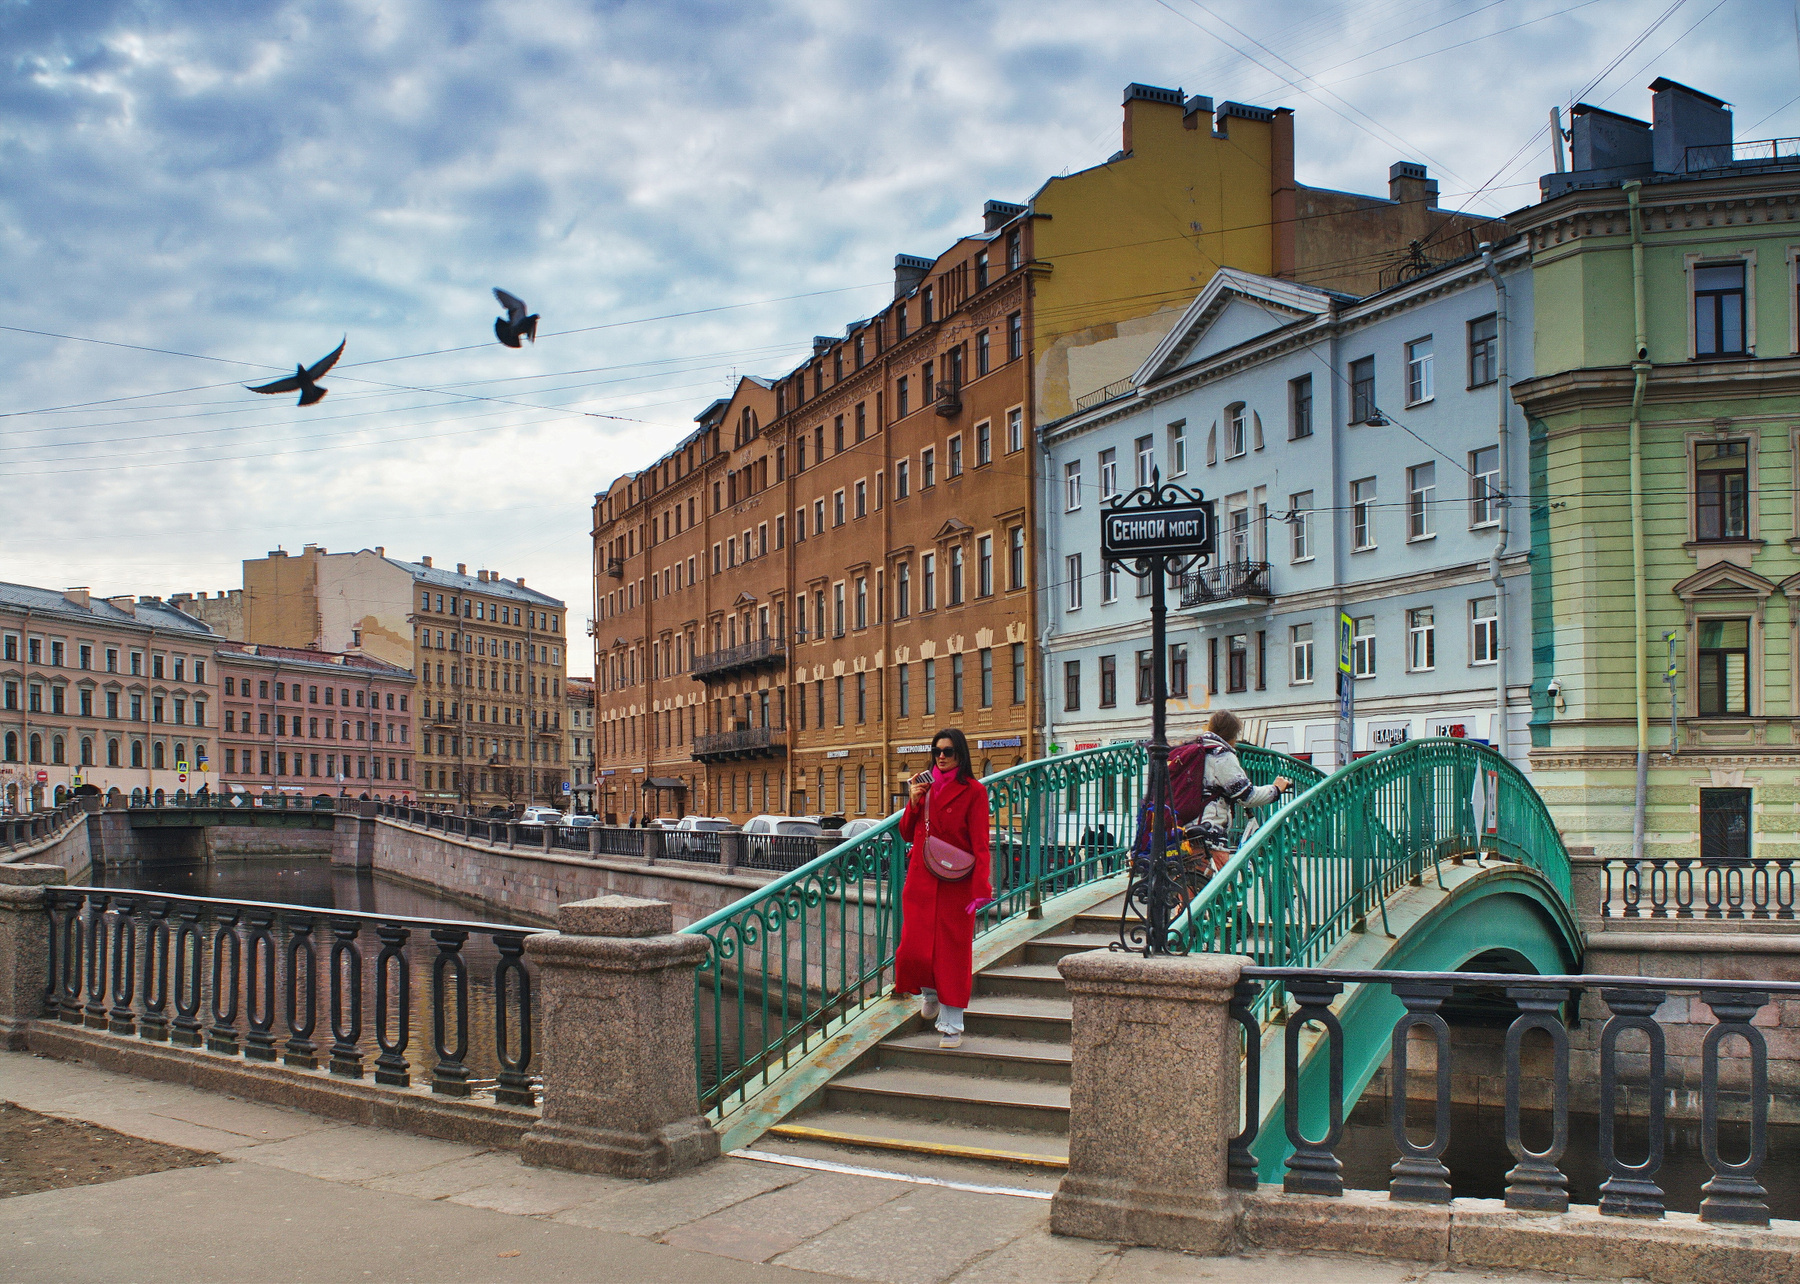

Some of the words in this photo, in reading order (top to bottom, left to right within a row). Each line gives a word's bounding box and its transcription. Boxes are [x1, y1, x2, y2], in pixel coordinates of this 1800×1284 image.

[1113, 519, 1165, 541] СЕННОЙ
[1169, 520, 1199, 537] МОСТ
[1373, 728, 1406, 743] ПЕКАРНЯ
